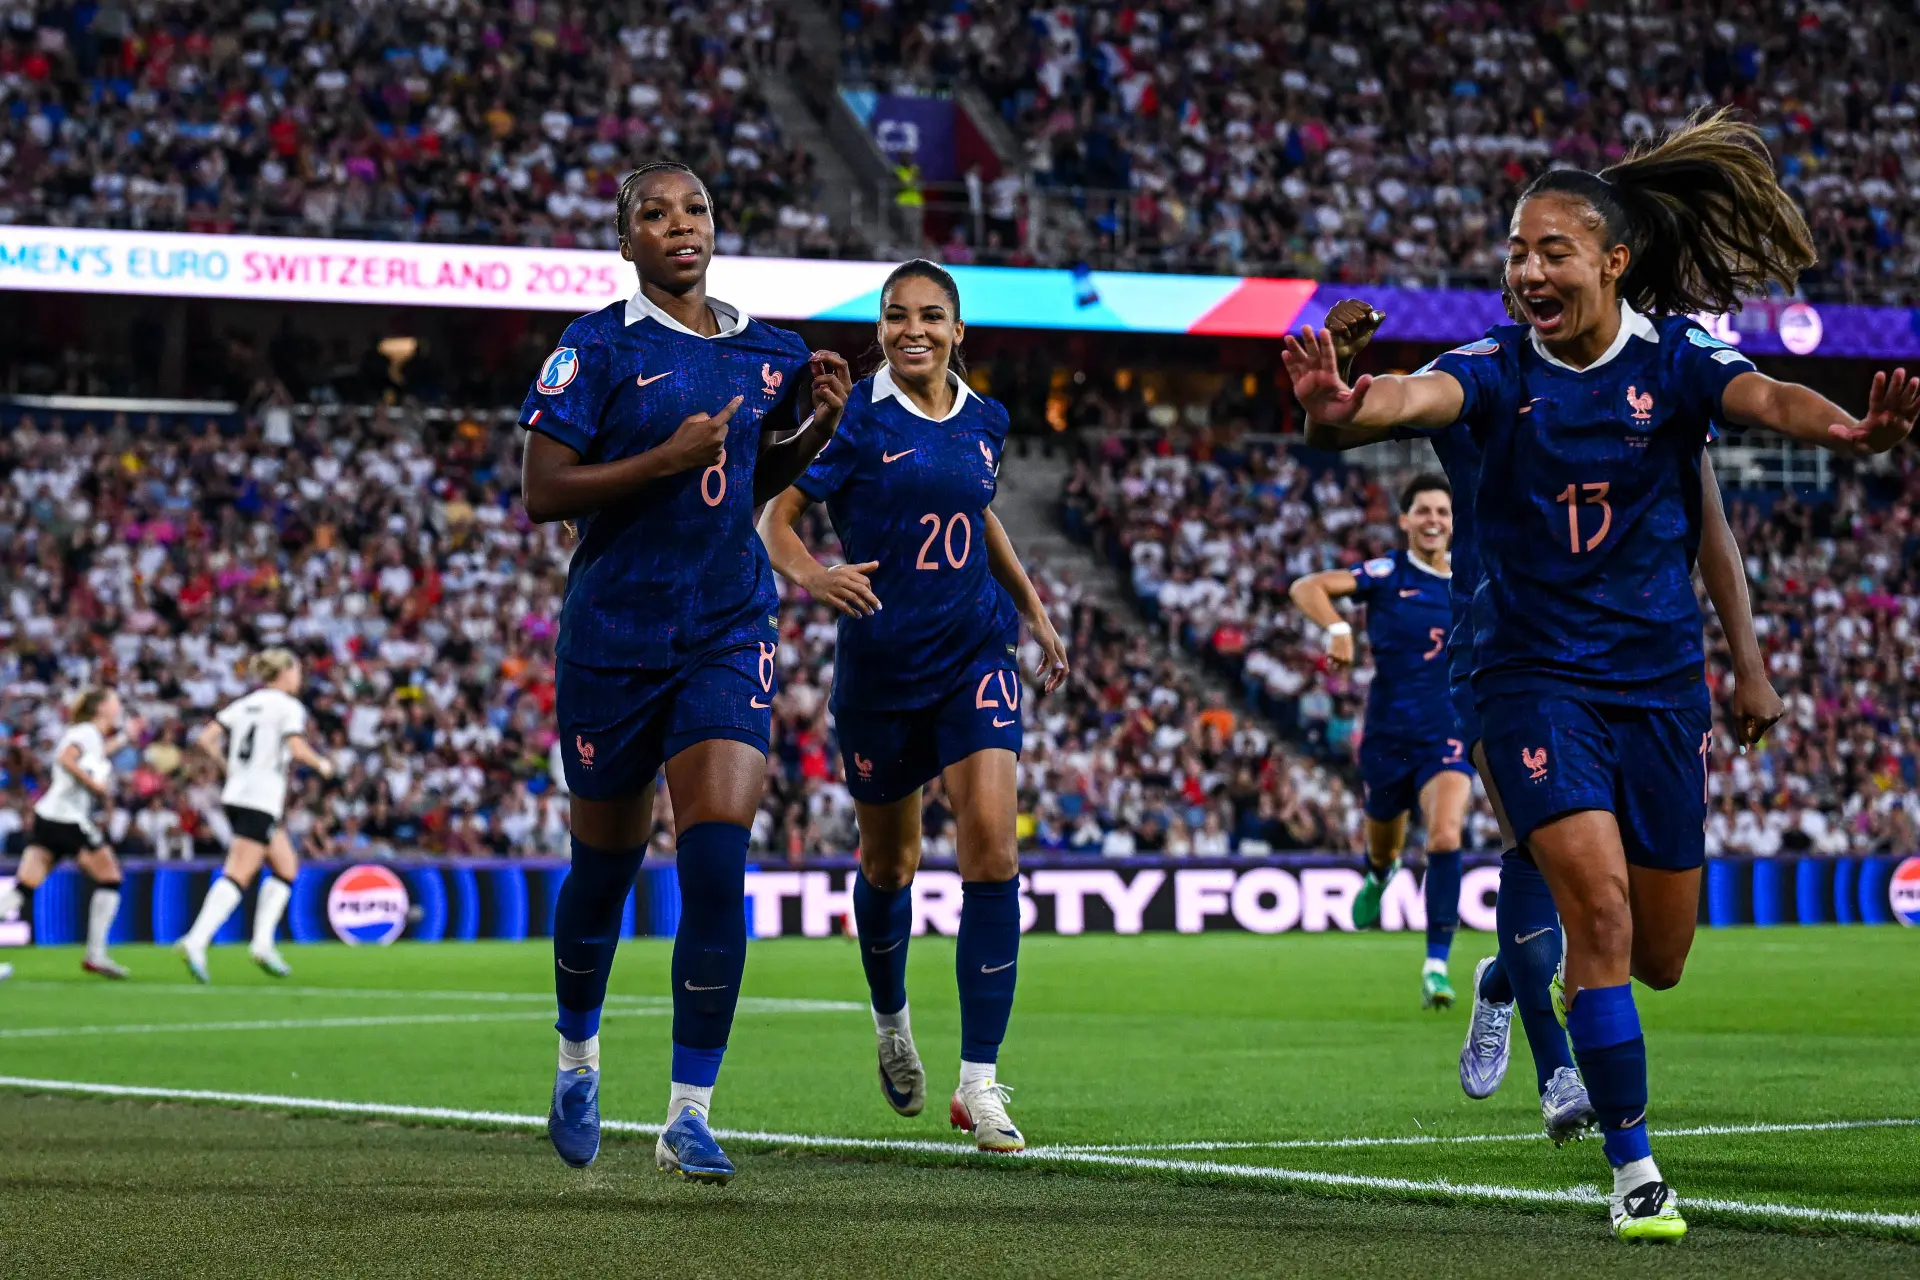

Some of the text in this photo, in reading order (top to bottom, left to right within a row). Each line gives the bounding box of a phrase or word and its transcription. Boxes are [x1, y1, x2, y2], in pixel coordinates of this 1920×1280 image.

[127, 247, 229, 281] EURO
[243, 251, 512, 294] SWITZERLAND
[526, 262, 618, 296] 2025
[701, 450, 727, 507] 8
[915, 512, 972, 570] 20
[1556, 481, 1612, 553] 13
[757, 641, 778, 693] 8
[1423, 627, 1446, 661] 5
[238, 721, 257, 764] 4
[743, 869, 1167, 938] THRTY
[1174, 866, 1367, 935] FOR
